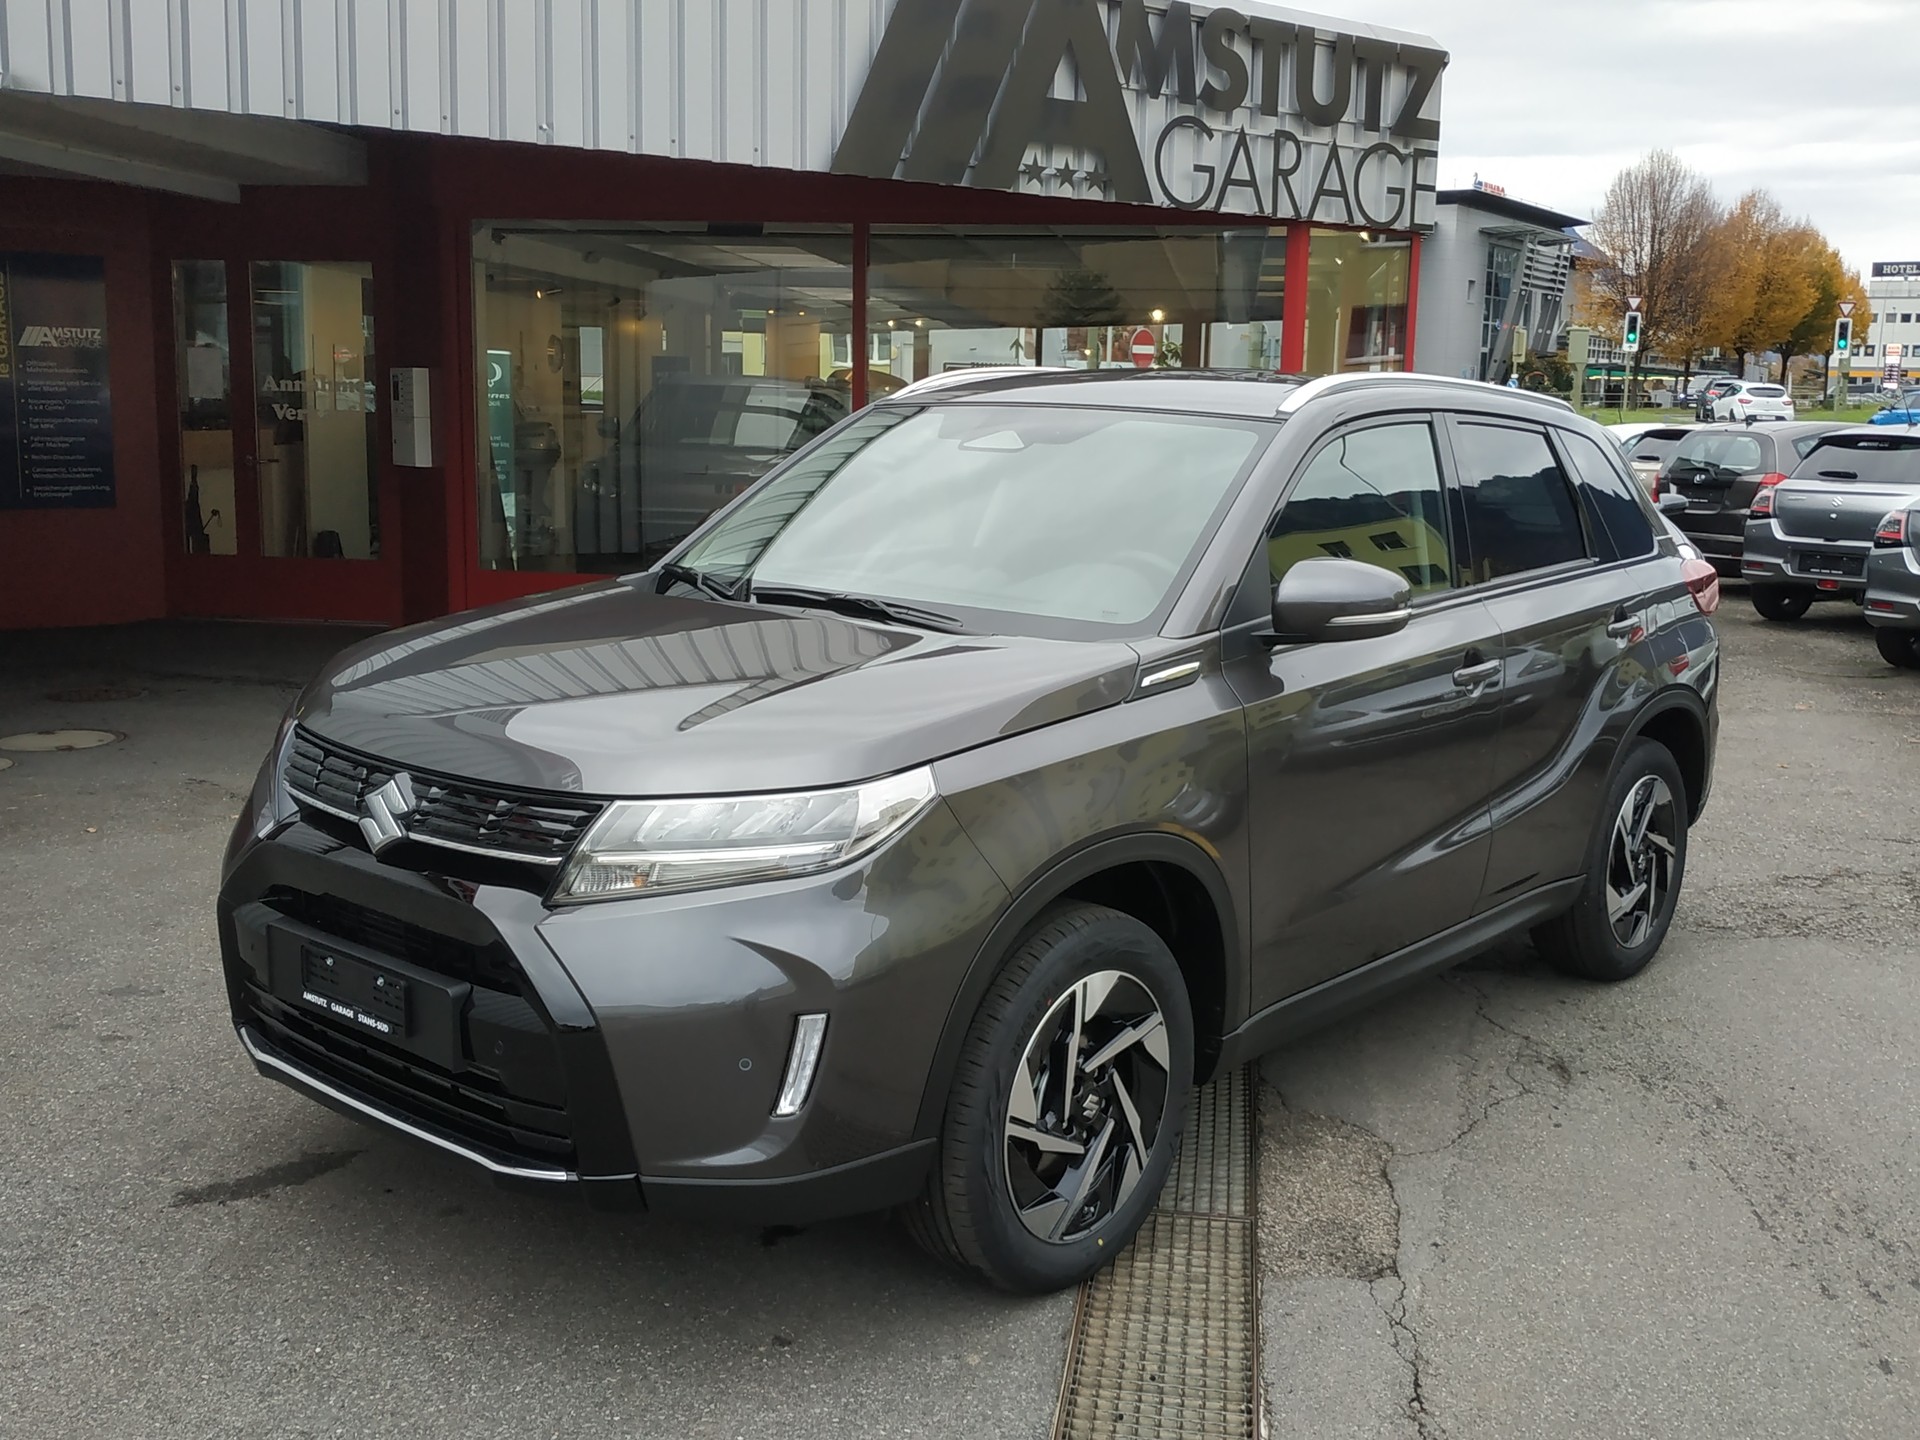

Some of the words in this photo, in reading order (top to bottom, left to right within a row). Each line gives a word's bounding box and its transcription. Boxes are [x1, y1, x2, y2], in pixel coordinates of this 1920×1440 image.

[962, 0, 1449, 204] AMSTUTZ
[1154, 115, 1438, 233] GARAGE
[1882, 264, 1920, 274] HOTEL
[36, 326, 102, 347] AMSTUTZ
[303, 991, 327, 1007] AMSTUTZ
[331, 1003, 353, 1018] GARAGE
